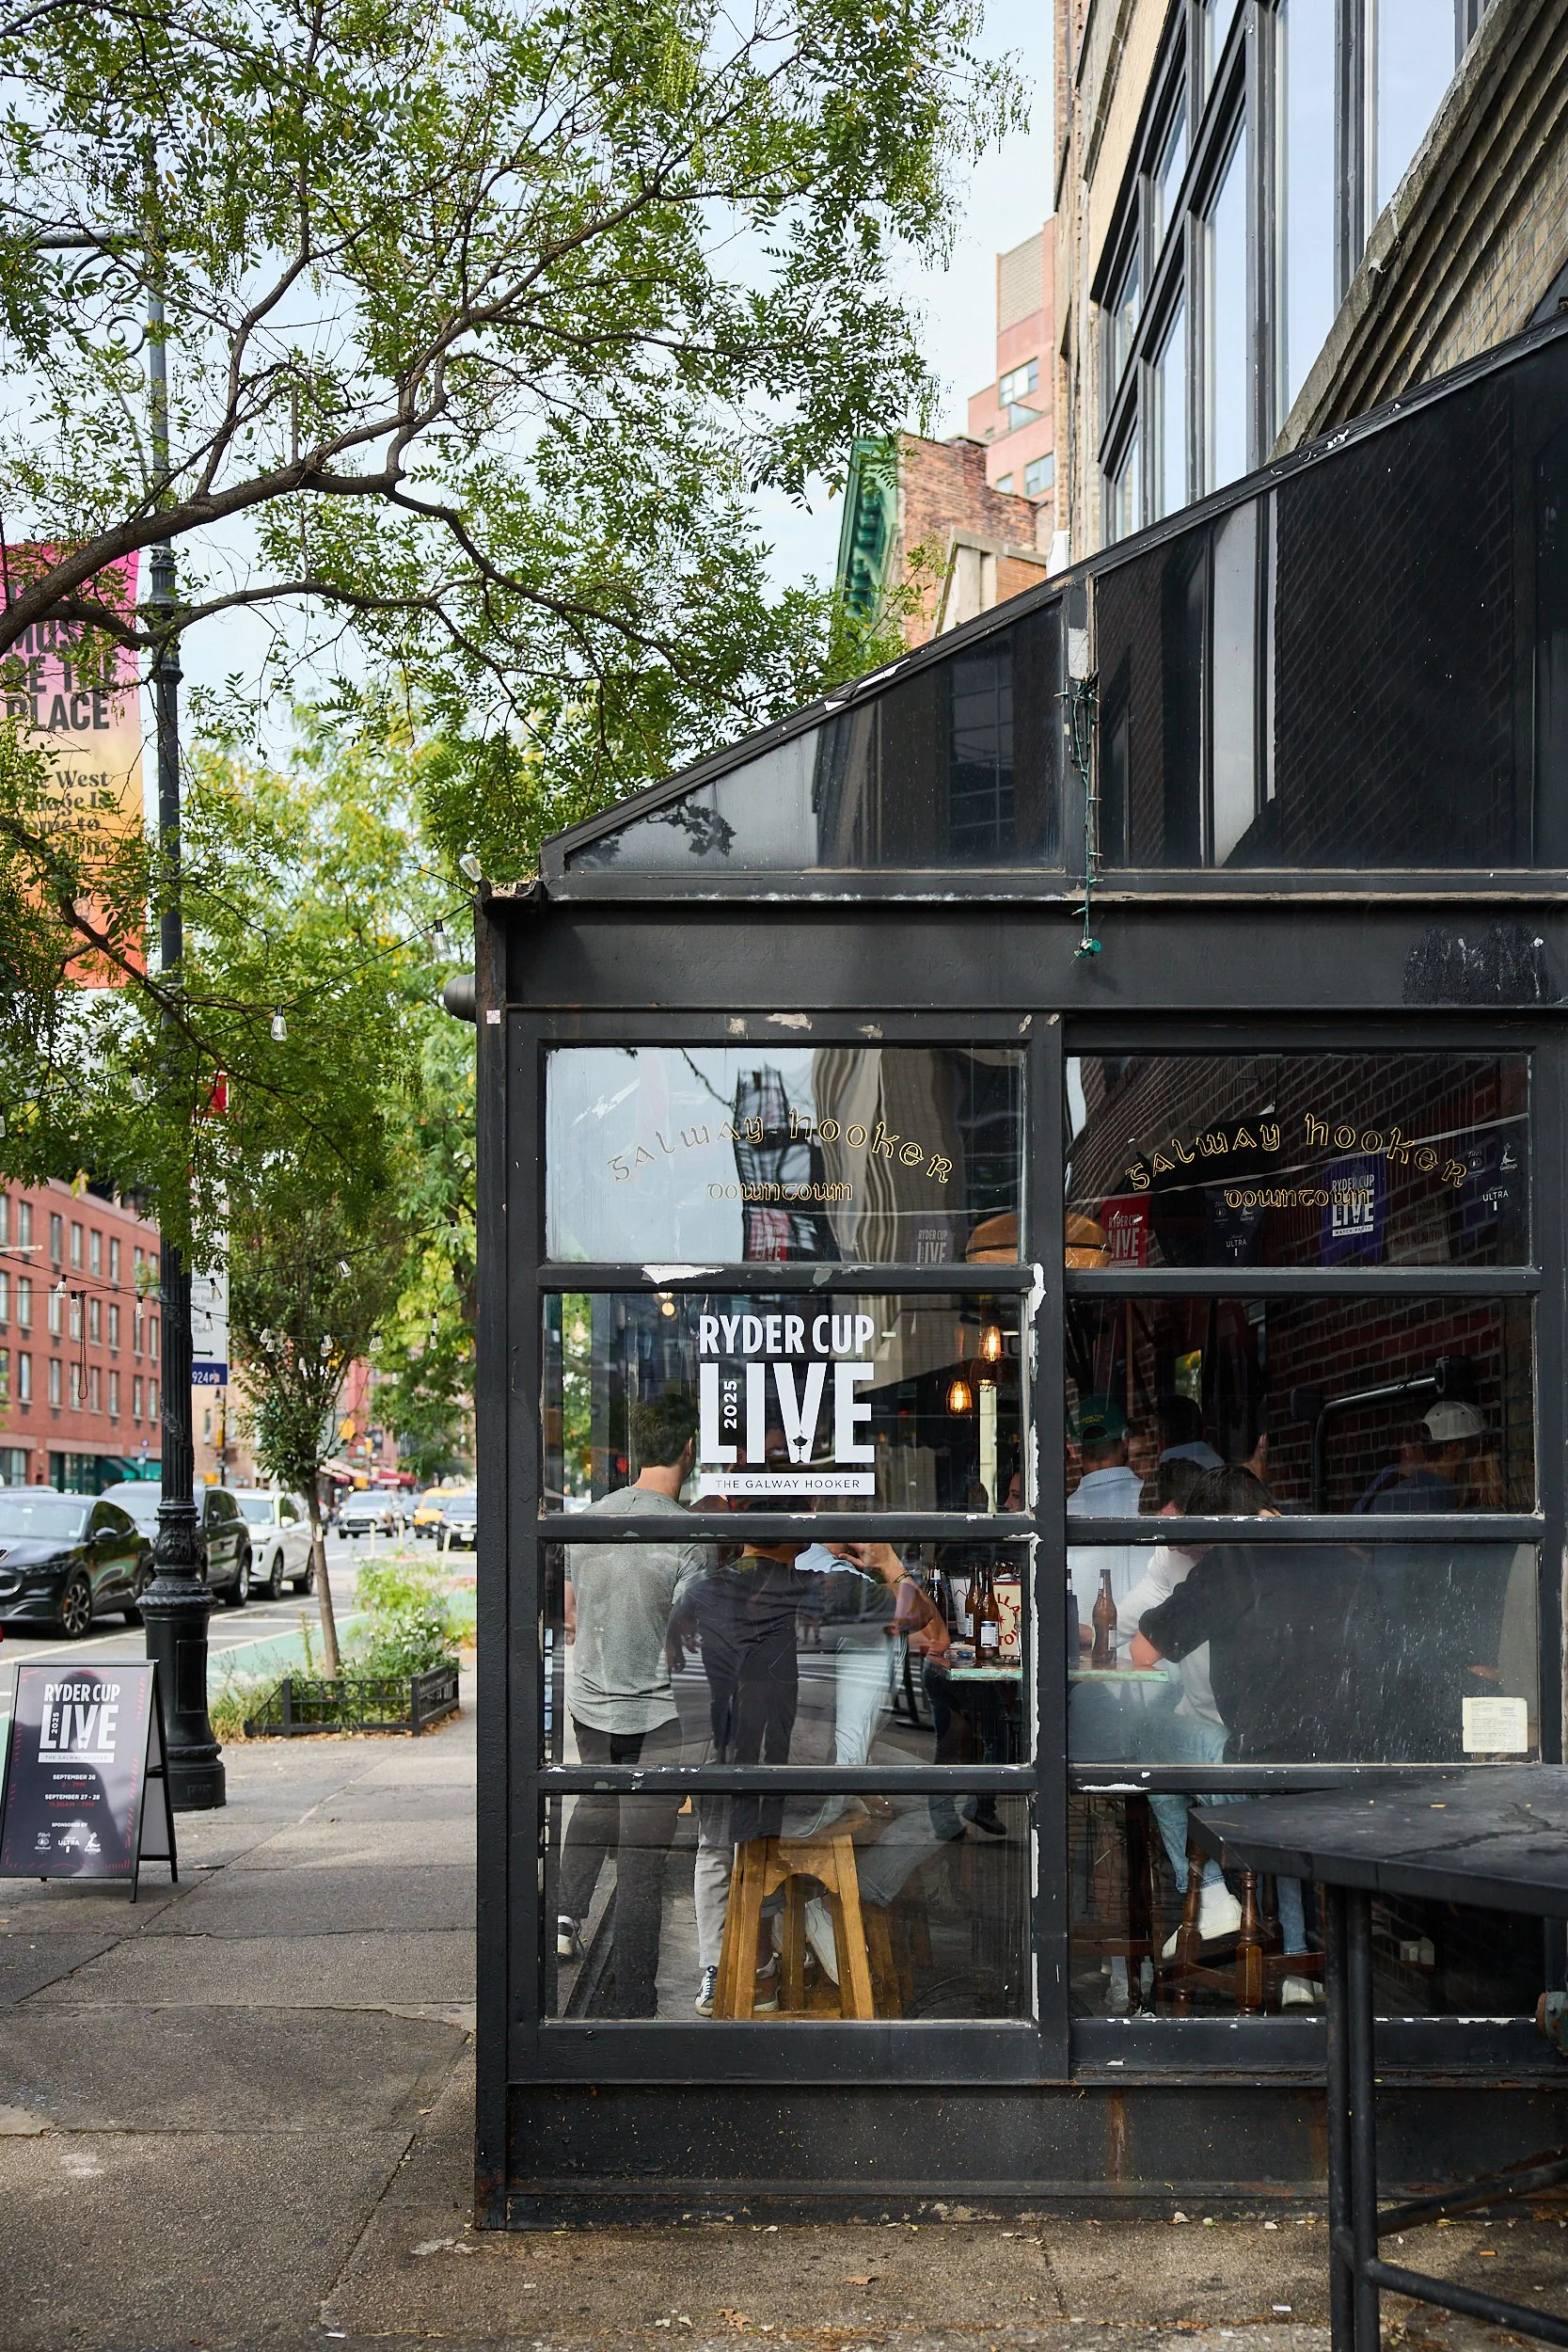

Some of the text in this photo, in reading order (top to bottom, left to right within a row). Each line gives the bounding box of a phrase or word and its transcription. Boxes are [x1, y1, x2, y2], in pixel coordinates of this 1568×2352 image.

[7, 694, 110, 731] PLACE
[55, 771, 110, 788] West
[78, 816, 101, 832] to
[1332, 1174, 1375, 1192] RYDER CUP
[1482, 1189, 1509, 1202] ULTRA
[1332, 1189, 1375, 1227] LIVE
[918, 1229, 948, 1240] RYDER CUP
[1226, 1238, 1247, 1248] ULTRA
[699, 1314, 875, 1354] RYDER CUP
[699, 1362, 875, 1464] LIVE
[723, 1379, 737, 1430] 2025
[716, 1479, 861, 1488] THE GALWAY HOOKER
[43, 1683, 120, 1702] RYDER CUP
[40, 1705, 119, 1749] LIVE
[51, 1711, 60, 1735] 2025
